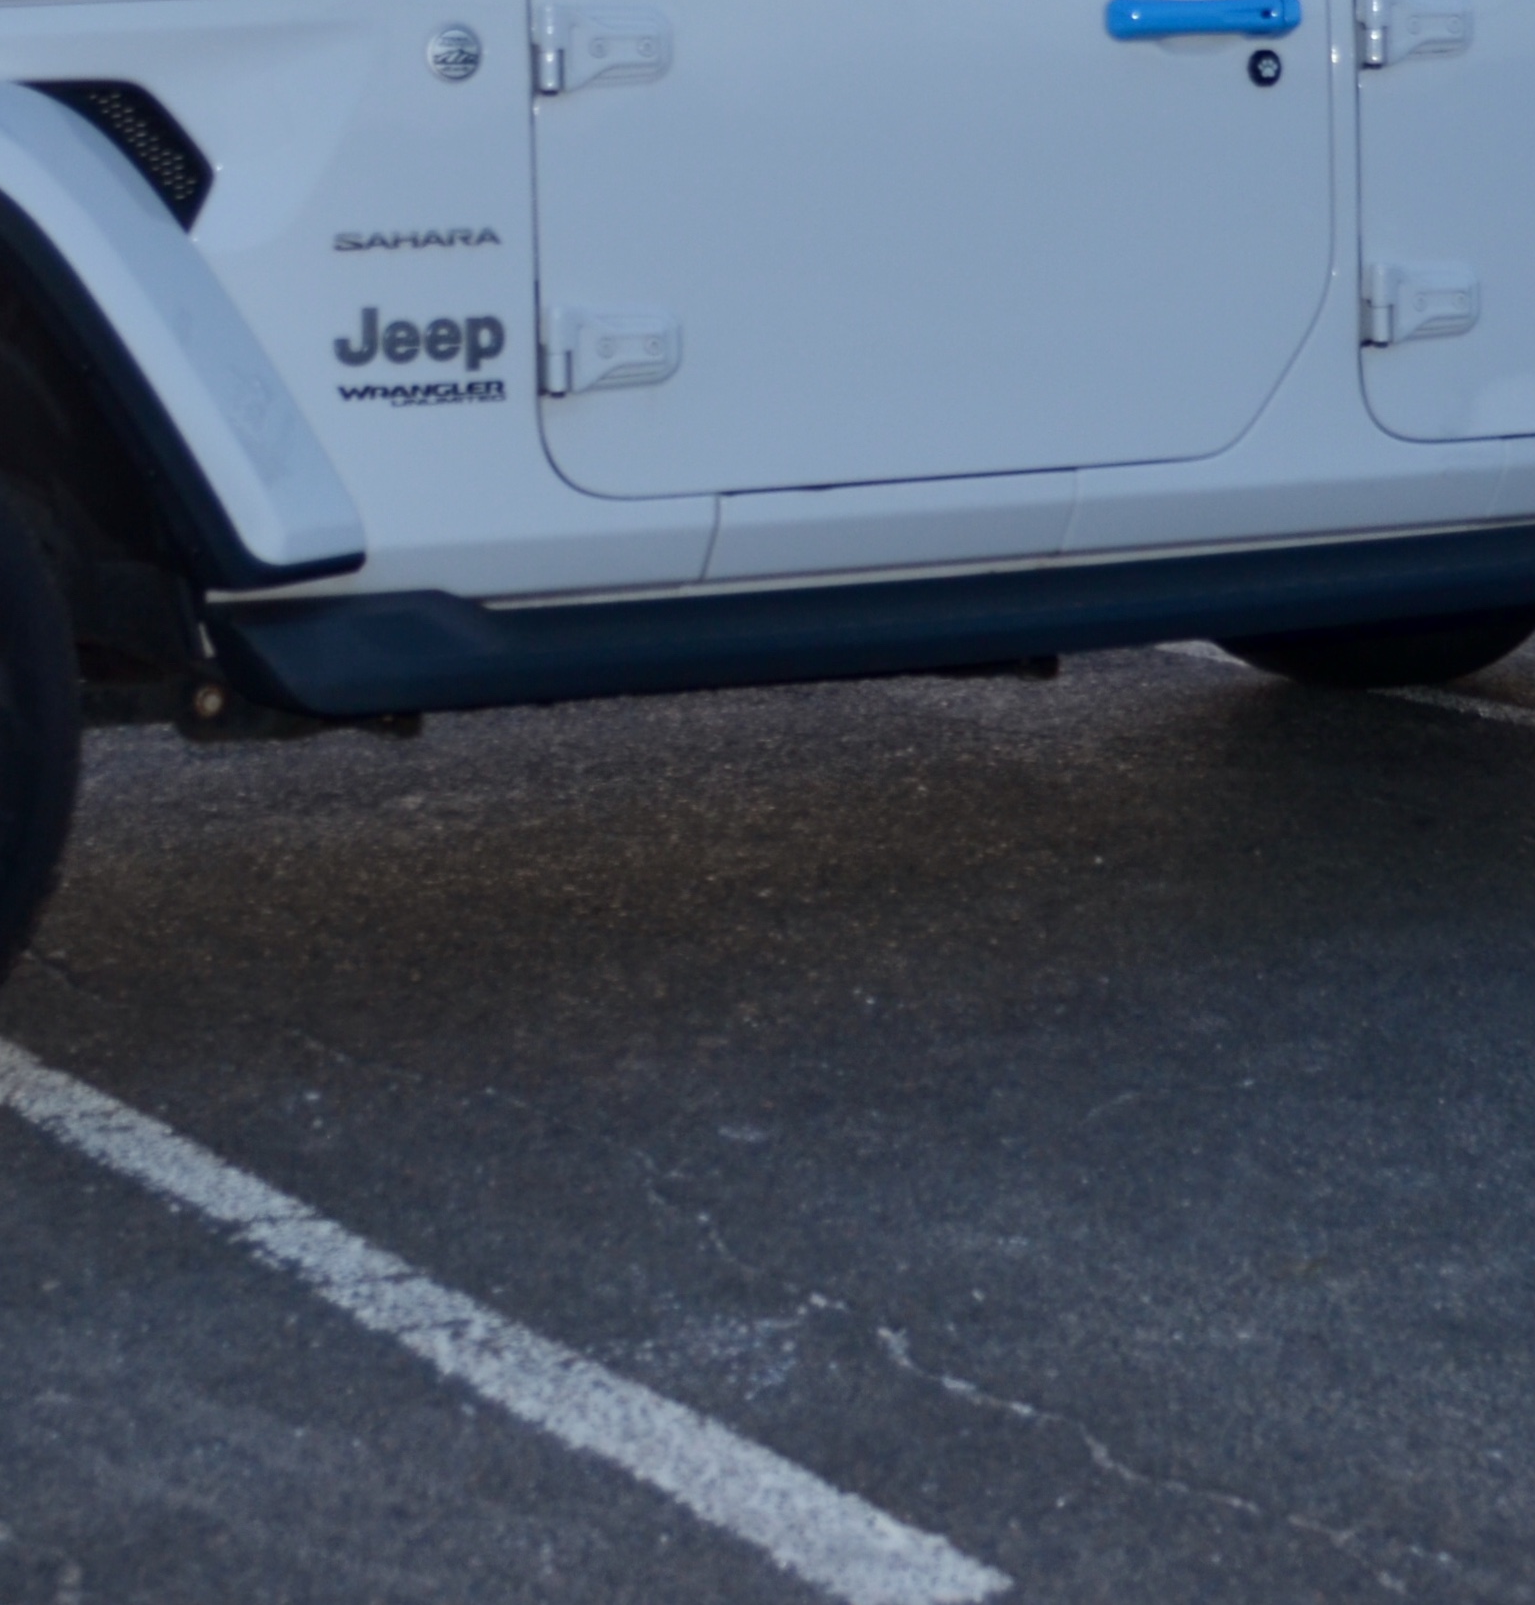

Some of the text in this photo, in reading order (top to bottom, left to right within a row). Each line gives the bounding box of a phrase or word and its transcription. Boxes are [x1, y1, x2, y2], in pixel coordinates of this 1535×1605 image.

[334, 228, 500, 251] SAHARA
[333, 307, 505, 372] Jeep
[337, 380, 505, 401] WRANGLER
